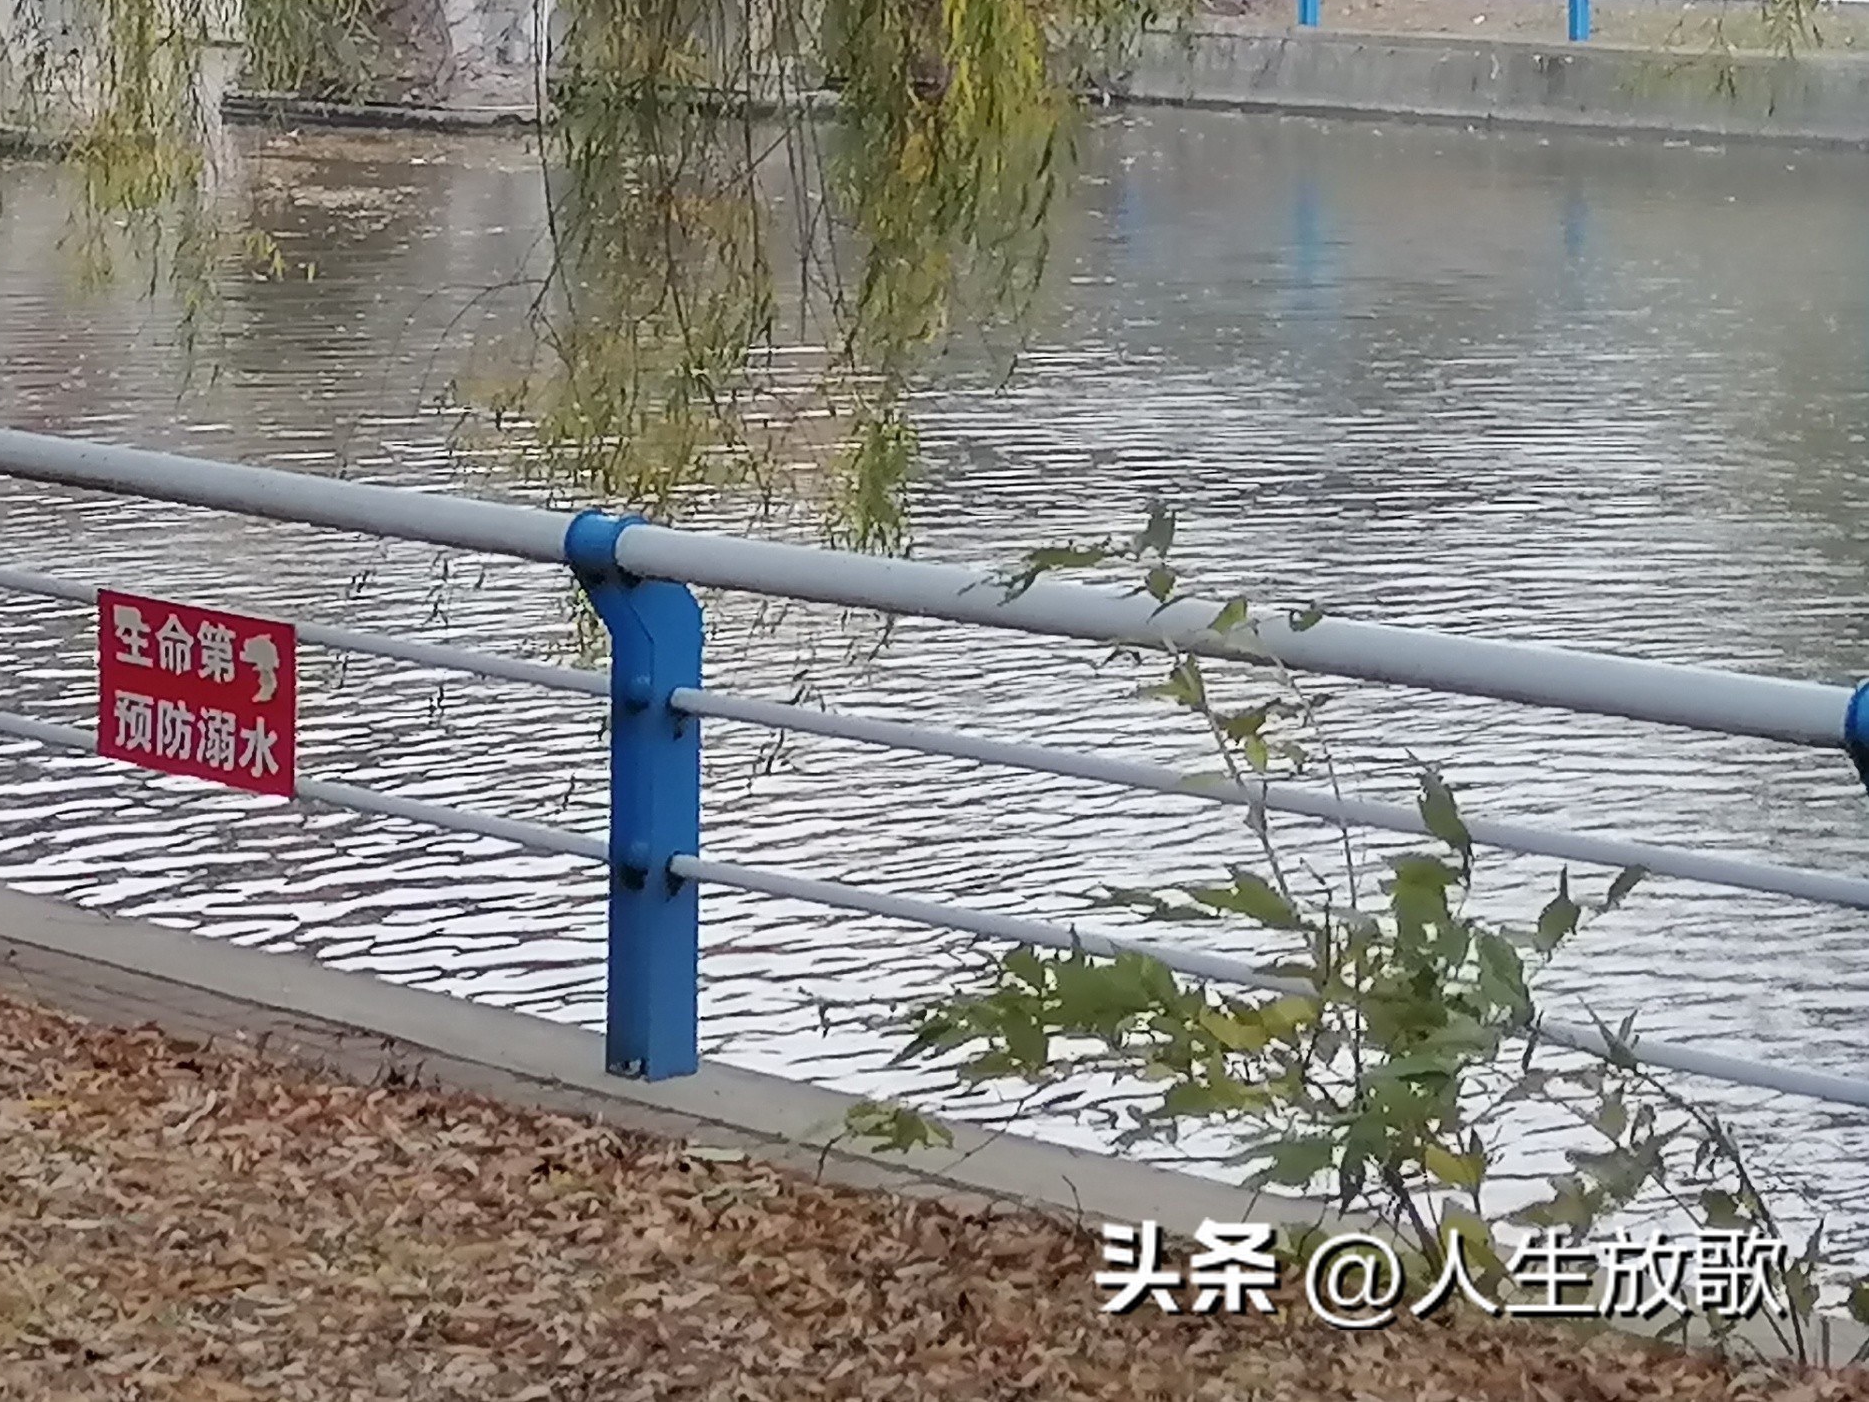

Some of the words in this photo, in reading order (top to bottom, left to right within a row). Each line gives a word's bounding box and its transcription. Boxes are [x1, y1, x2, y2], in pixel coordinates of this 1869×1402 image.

[112, 603, 280, 704] 生命第
[113, 688, 280, 778] 预防溺水
